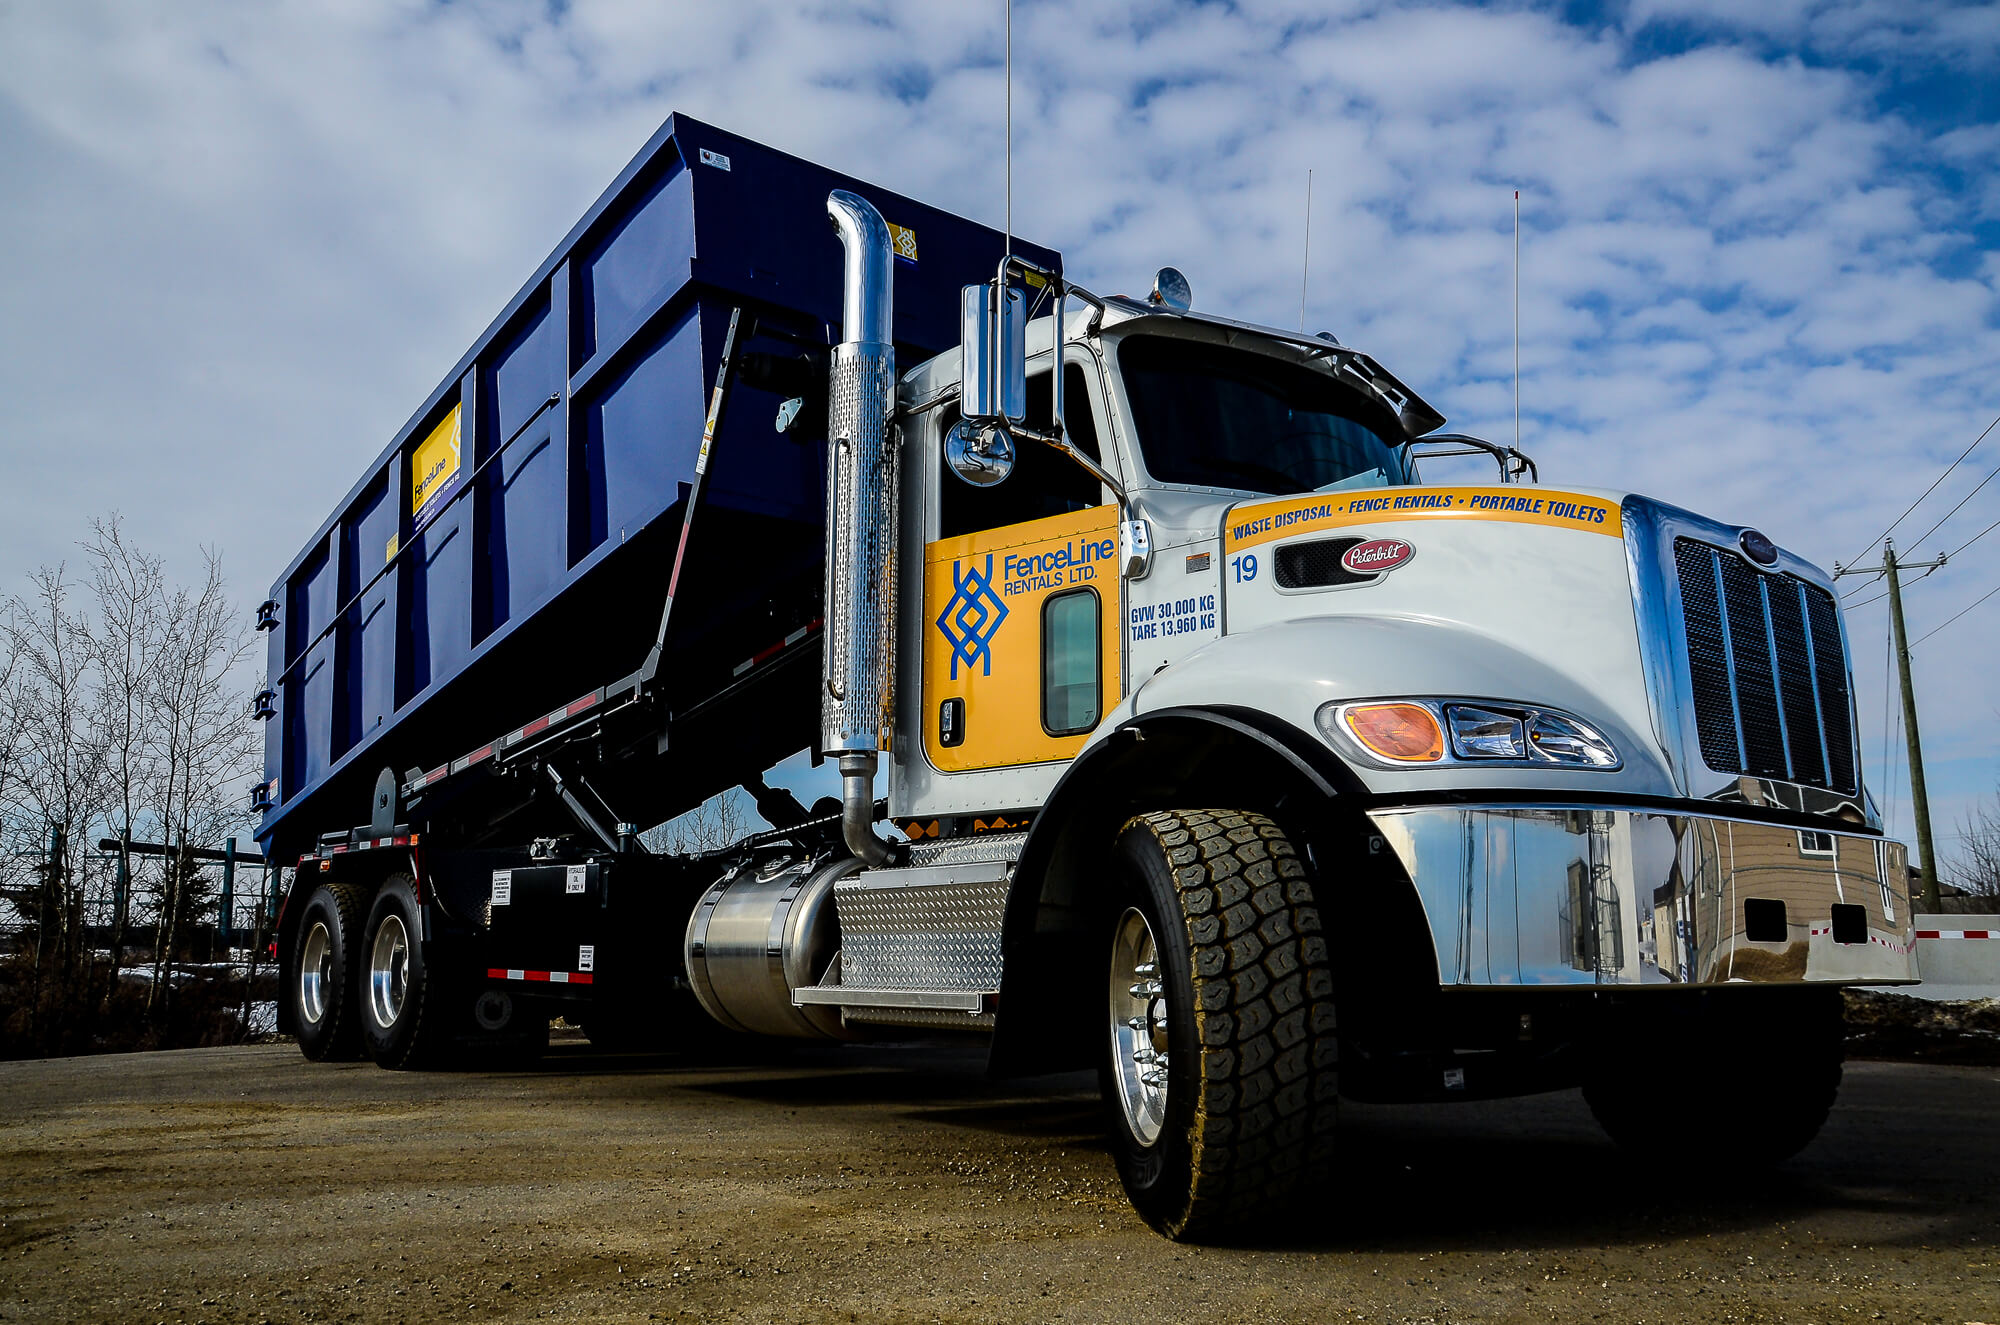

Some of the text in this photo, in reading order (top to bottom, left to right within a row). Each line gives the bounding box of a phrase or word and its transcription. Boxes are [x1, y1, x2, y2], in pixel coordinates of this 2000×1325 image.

[1233, 494, 1607, 540] WASTE DISPOSAL FENCE RENTALS PORTABLE TOILETS
[1004, 538, 1114, 580] FenceLine
[1231, 554, 1258, 584] 19
[1350, 543, 1405, 567] Peterbilt
[1004, 565, 1099, 597] RENTALS LTD.
[1131, 594, 1215, 624] GVW 30,000 KG
[1131, 613, 1216, 641] TARE 13,960 KG
